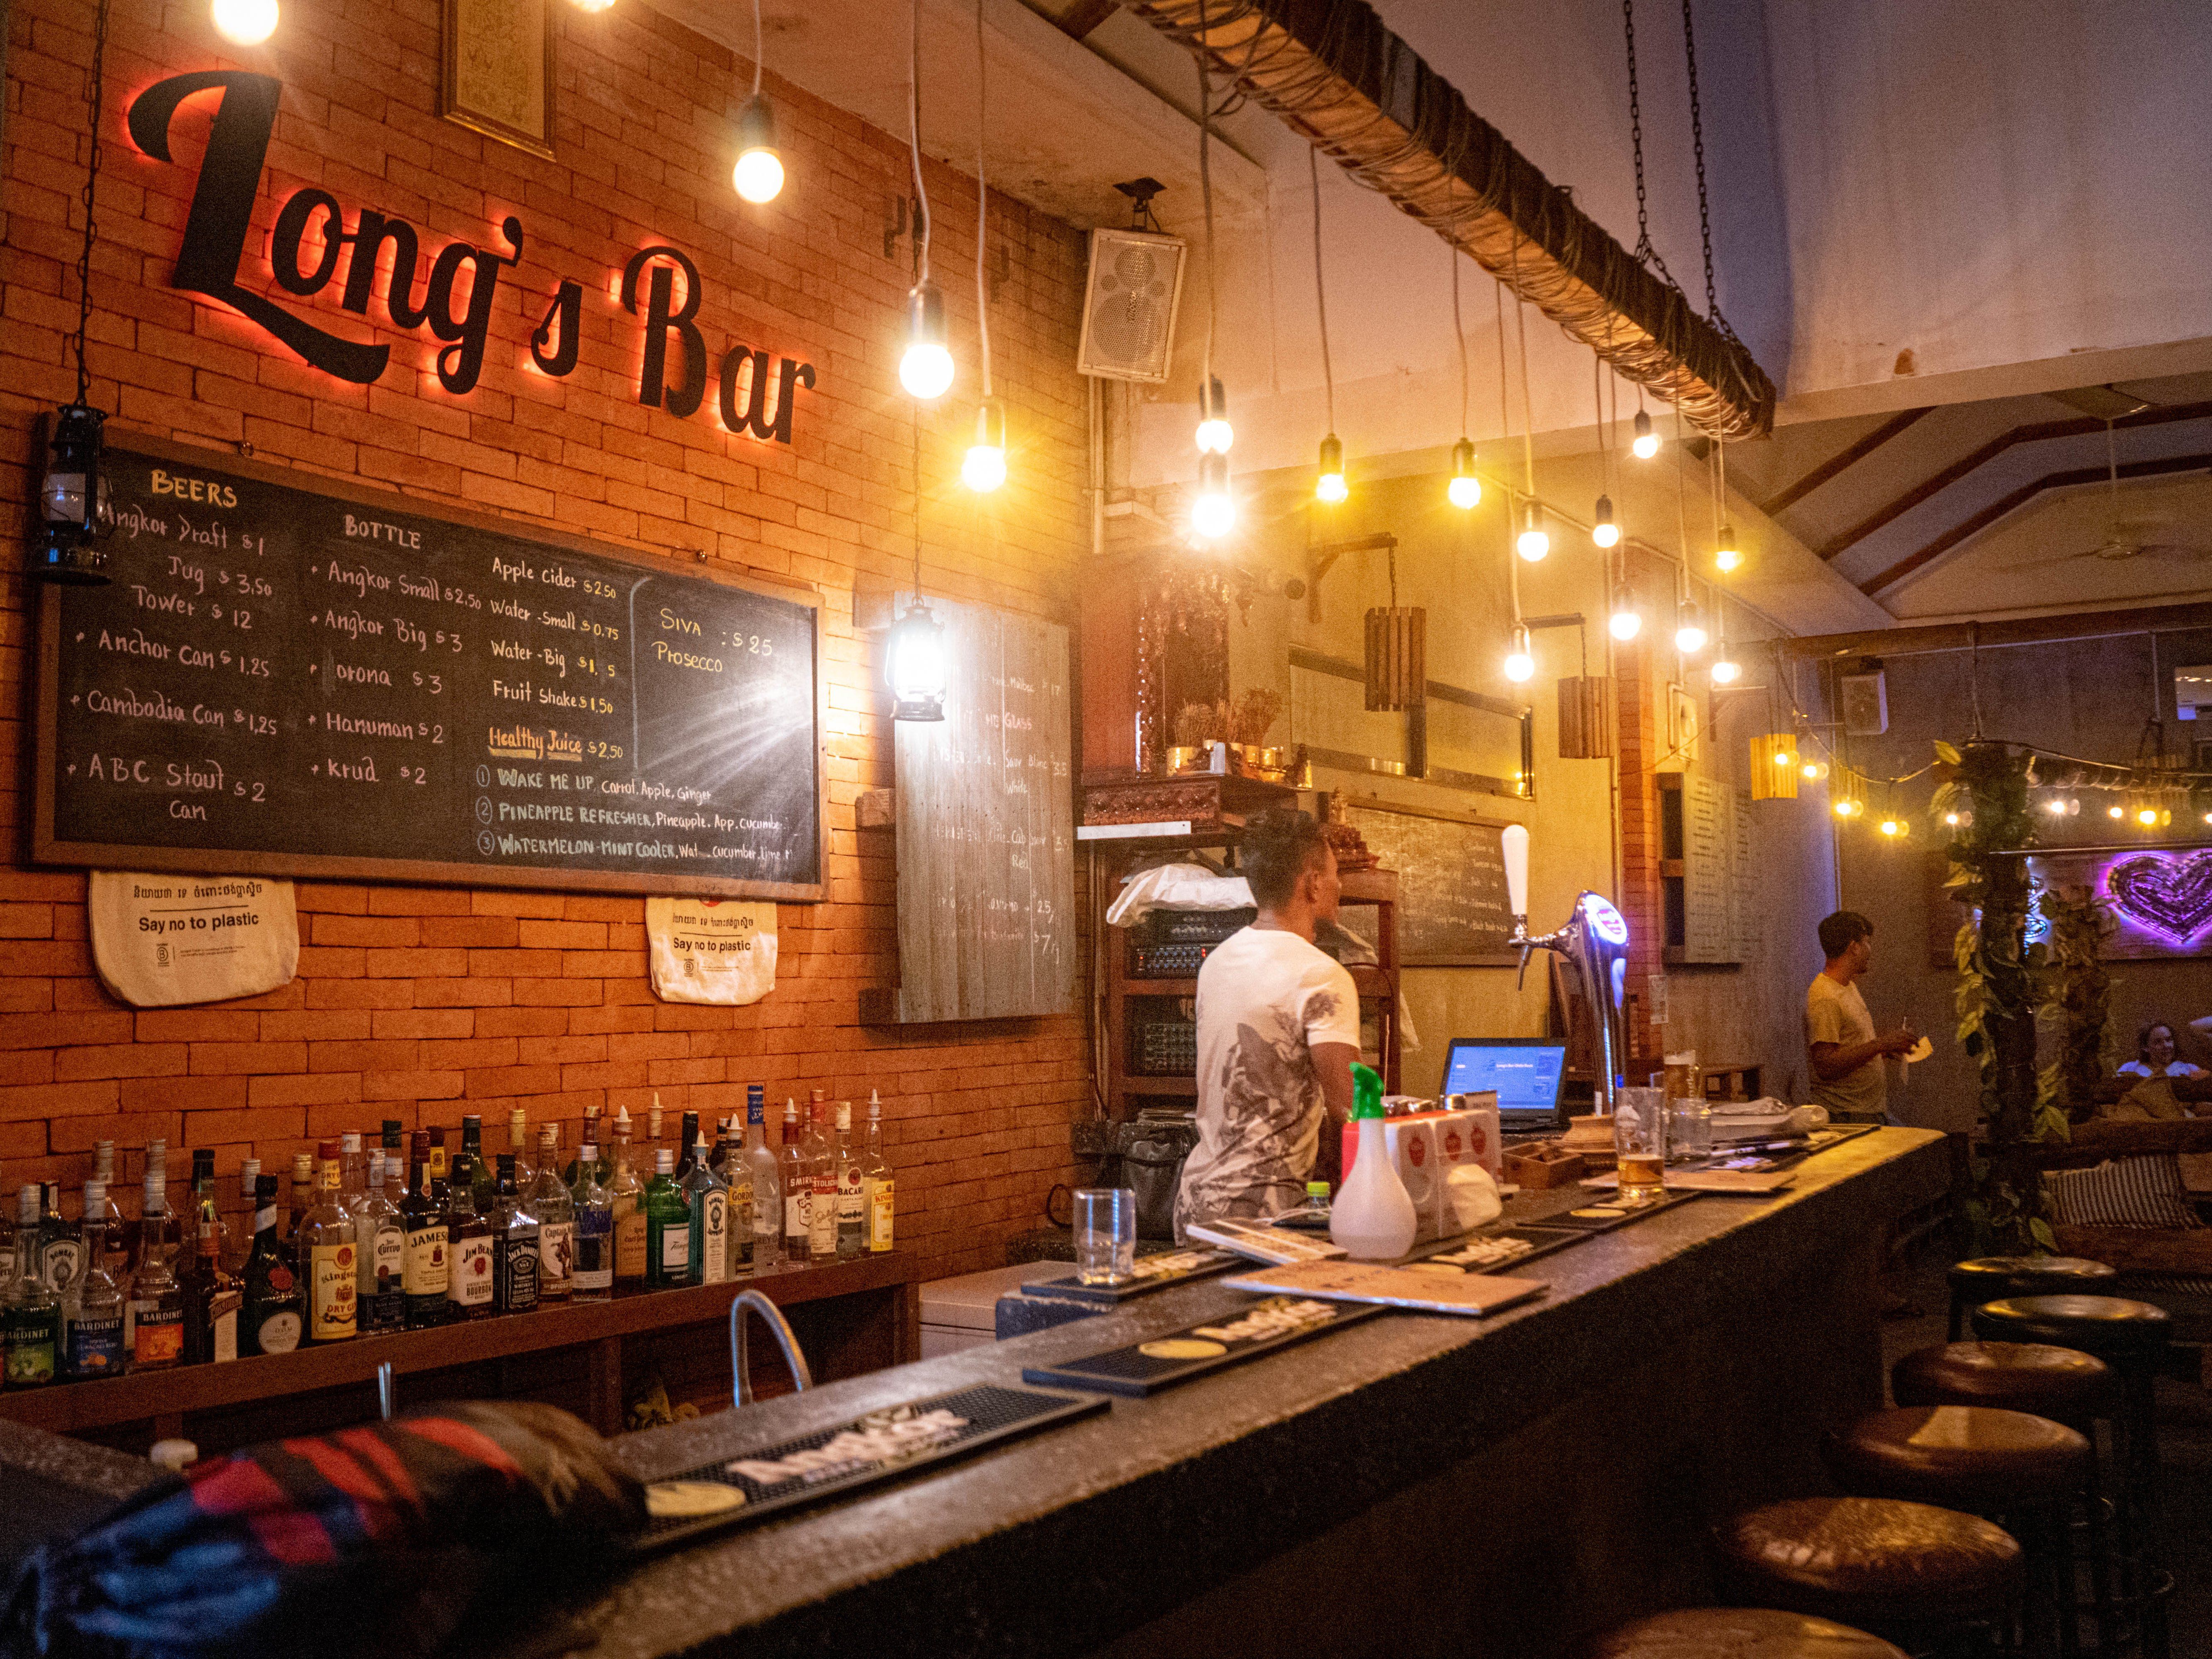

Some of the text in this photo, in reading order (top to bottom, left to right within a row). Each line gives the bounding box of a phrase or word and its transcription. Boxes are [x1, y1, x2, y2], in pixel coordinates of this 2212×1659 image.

[127, 70, 816, 445] Long's Bar
[151, 469, 237, 508] BEERS
[103, 503, 168, 538] Angkor
[179, 514, 227, 548] Draft
[343, 514, 421, 549] BOTTLE
[168, 556, 204, 595] Jug
[329, 560, 391, 598] Angkor
[398, 574, 440, 601] Small
[492, 557, 534, 583] Apple
[131, 585, 195, 616] Tower
[491, 599, 531, 621] Water
[325, 610, 384, 640] Angkor
[393, 618, 427, 652] Big
[99, 628, 170, 659] Anchor
[179, 645, 214, 669] Can
[491, 640, 532, 660] Water
[334, 664, 392, 686] orona
[88, 688, 185, 722] Cambodia
[192, 705, 224, 727] Can
[493, 680, 531, 702] Fruit
[539, 688, 577, 707] Shake
[327, 713, 414, 740] Hanuman
[489, 725, 544, 759] Healthy
[547, 730, 581, 753] Juice
[166, 759, 224, 791] Stout
[498, 768, 544, 788] WAKE
[550, 774, 568, 789] ME
[677, 786, 711, 806] Ginger
[170, 800, 207, 820] Can
[139, 912, 259, 934] Say no to plastic
[674, 937, 751, 953] Say no to plastic
[467, 1284, 492, 1297] BOURBON
[327, 1304, 345, 1313] DRY
